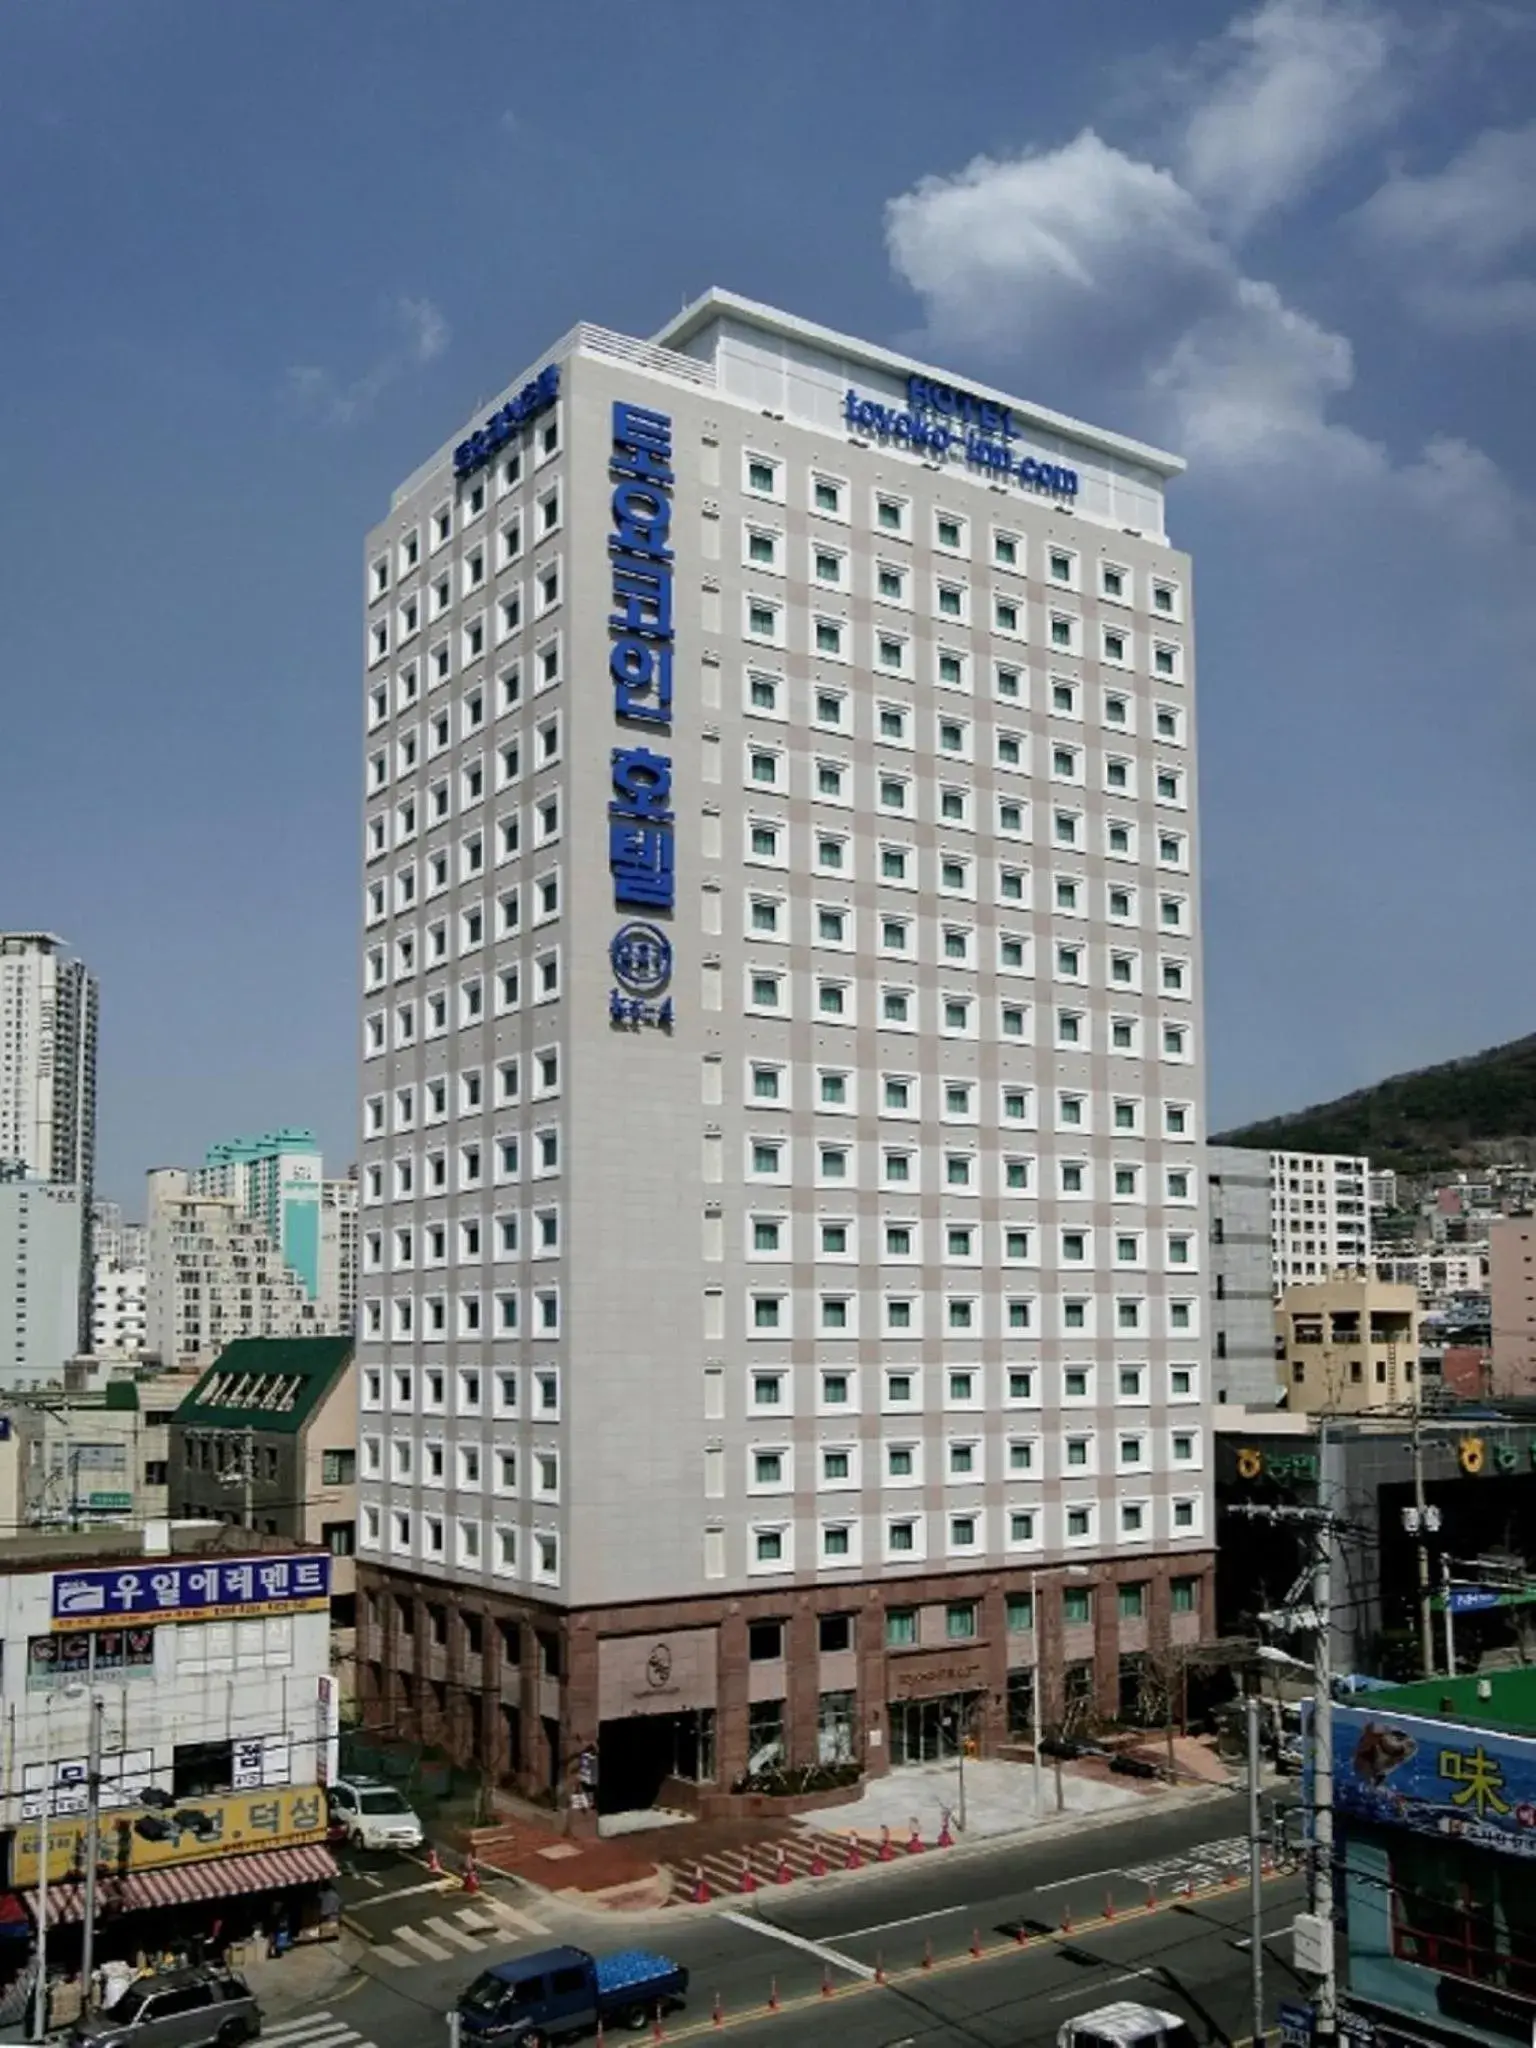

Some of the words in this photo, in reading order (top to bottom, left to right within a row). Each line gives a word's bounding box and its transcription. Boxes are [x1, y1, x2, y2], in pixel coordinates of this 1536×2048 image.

[846, 388, 1079, 495] toyoko-inn.com
[908, 375, 1023, 440] HOTEL
[607, 400, 676, 726] 토요코인
[608, 746, 675, 908] 호텔
[110, 1562, 324, 1611] 우일에레멘트
[31, 1630, 153, 1661] CCTV
[1439, 1743, 1511, 1817] 味
